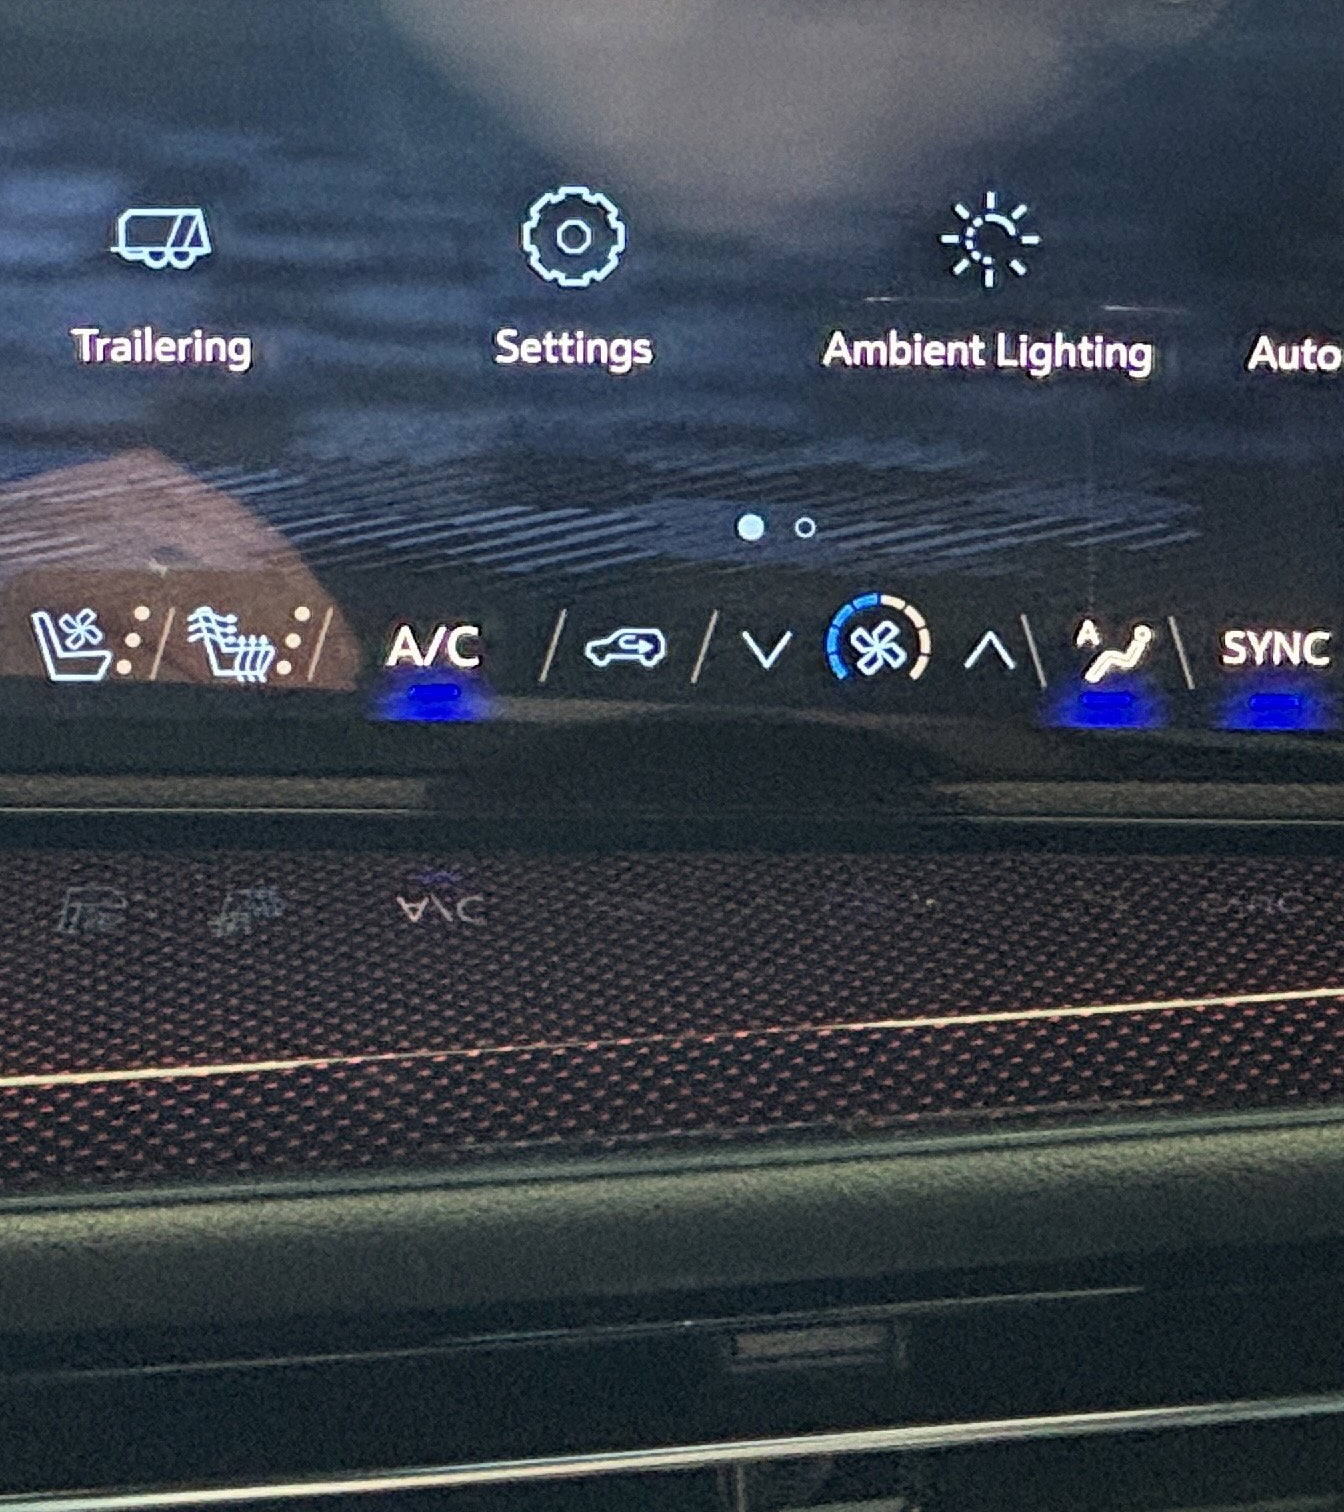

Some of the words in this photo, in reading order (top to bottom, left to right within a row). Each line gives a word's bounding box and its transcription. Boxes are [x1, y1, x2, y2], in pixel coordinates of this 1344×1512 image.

[69, 325, 254, 376] Trailering
[493, 327, 655, 377] Settings
[821, 327, 987, 369] Ambient
[996, 330, 1156, 381] Lighting
[1246, 334, 1344, 374] Auto
[385, 624, 481, 670] A/C
[1221, 629, 1333, 667] SYNC
